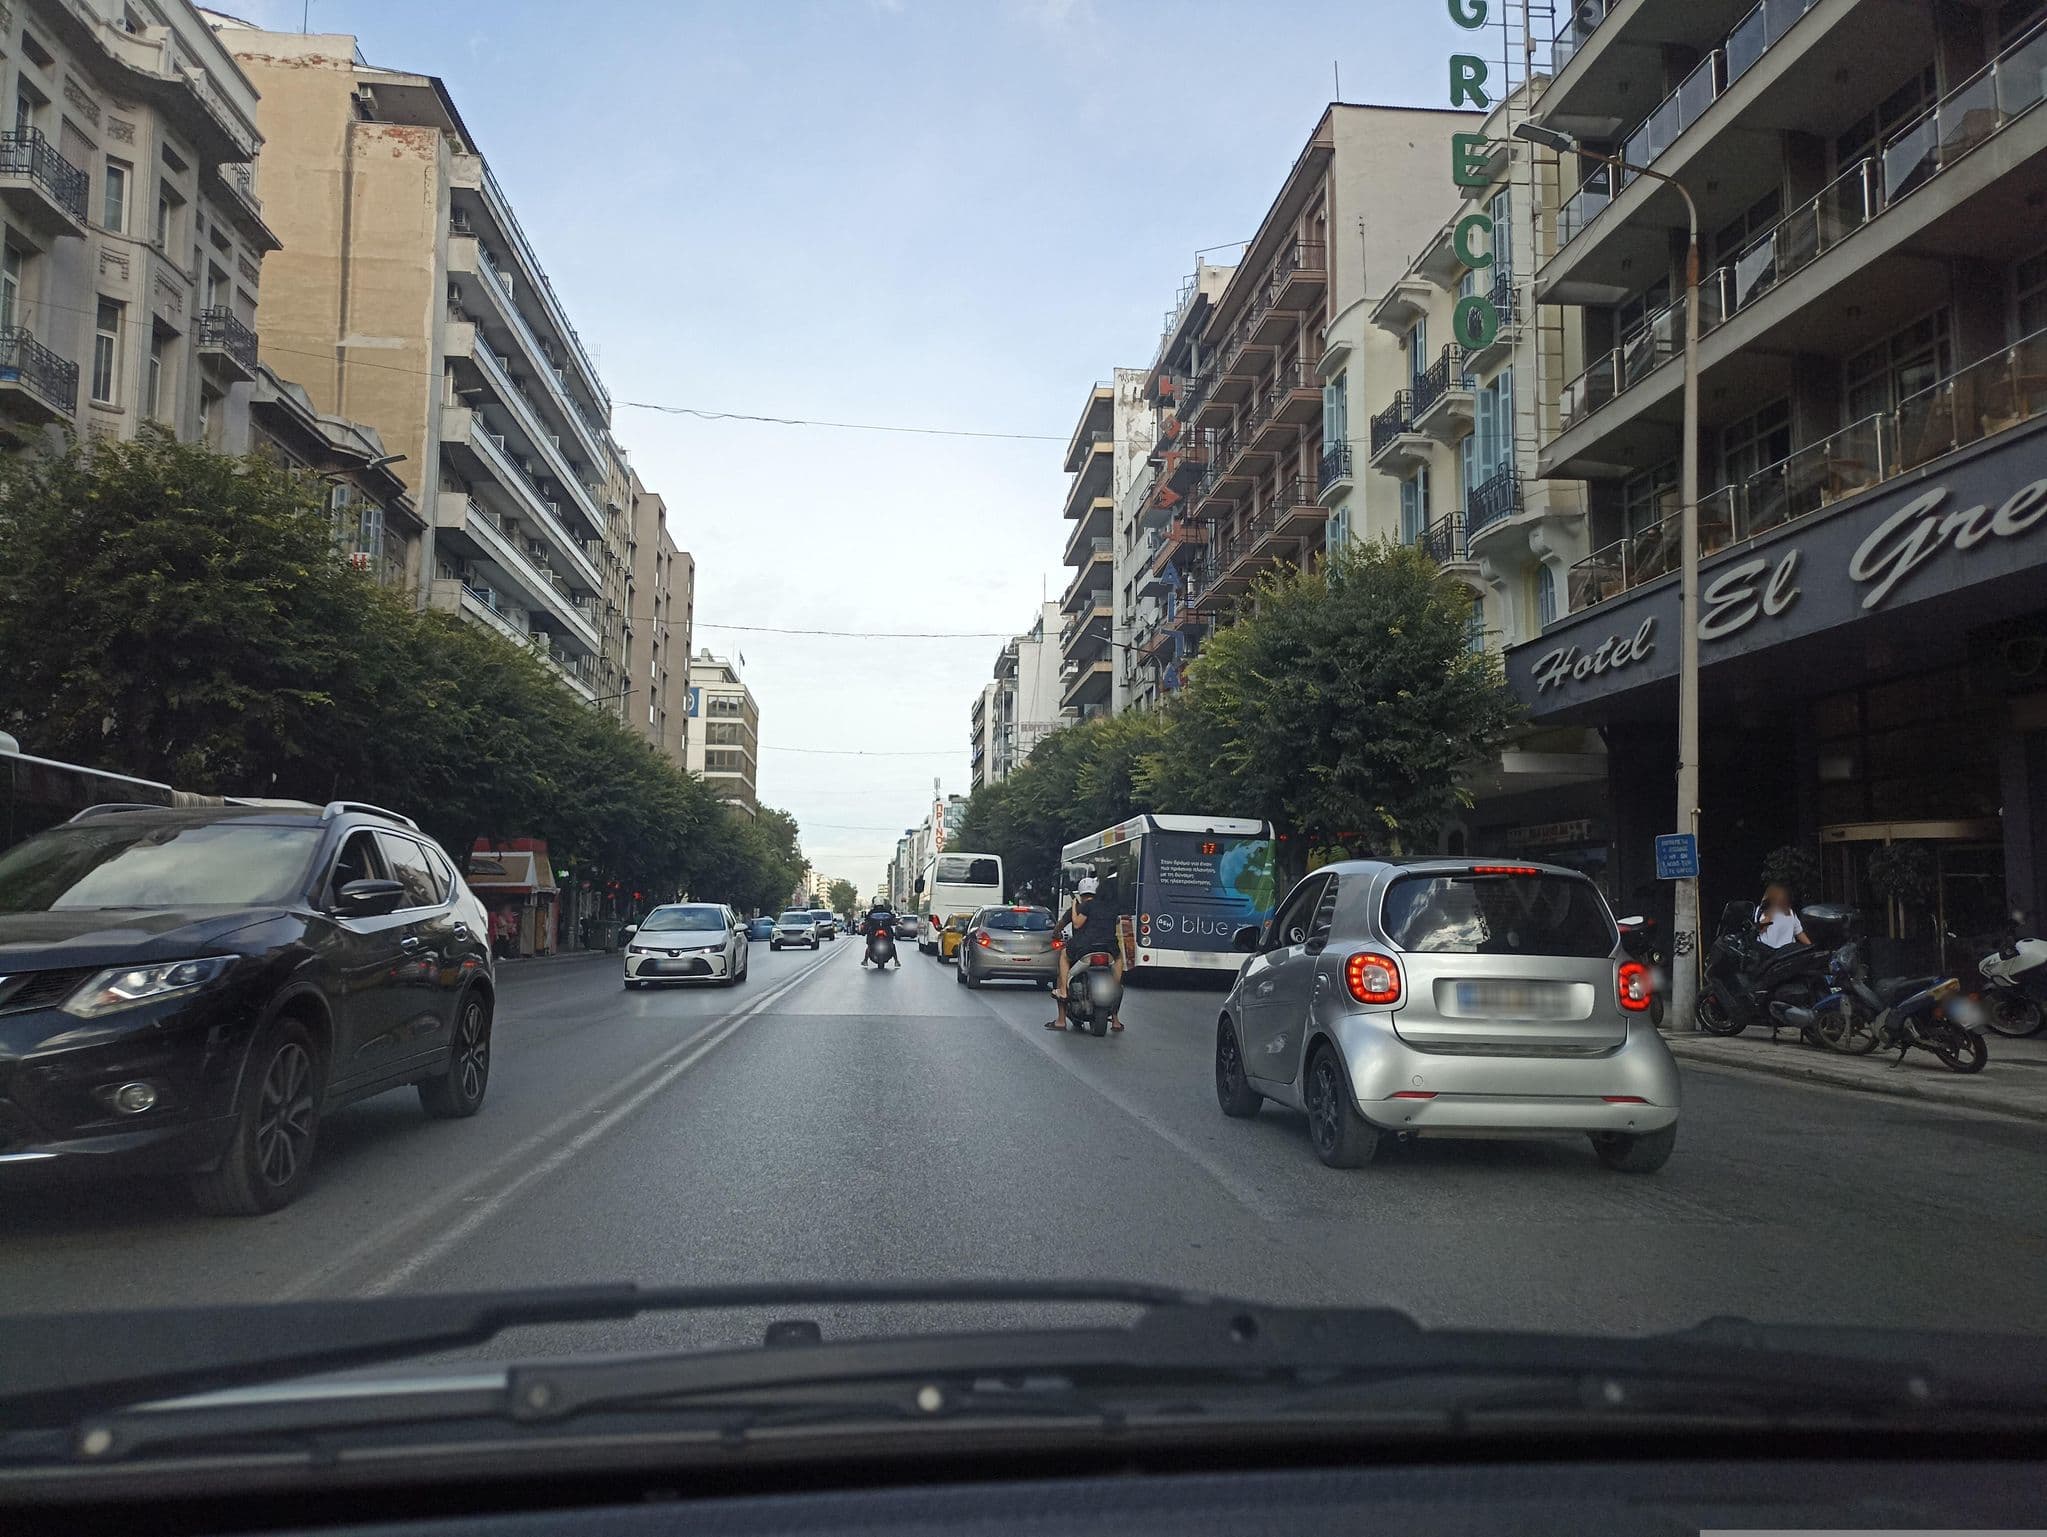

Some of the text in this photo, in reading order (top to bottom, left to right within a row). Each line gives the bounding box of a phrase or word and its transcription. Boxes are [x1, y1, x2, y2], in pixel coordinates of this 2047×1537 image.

[1447, 0, 1497, 351] GRECO
[1531, 616, 1656, 694] Hotel
[1699, 548, 1801, 641] El
[1182, 915, 1228, 935] blue
